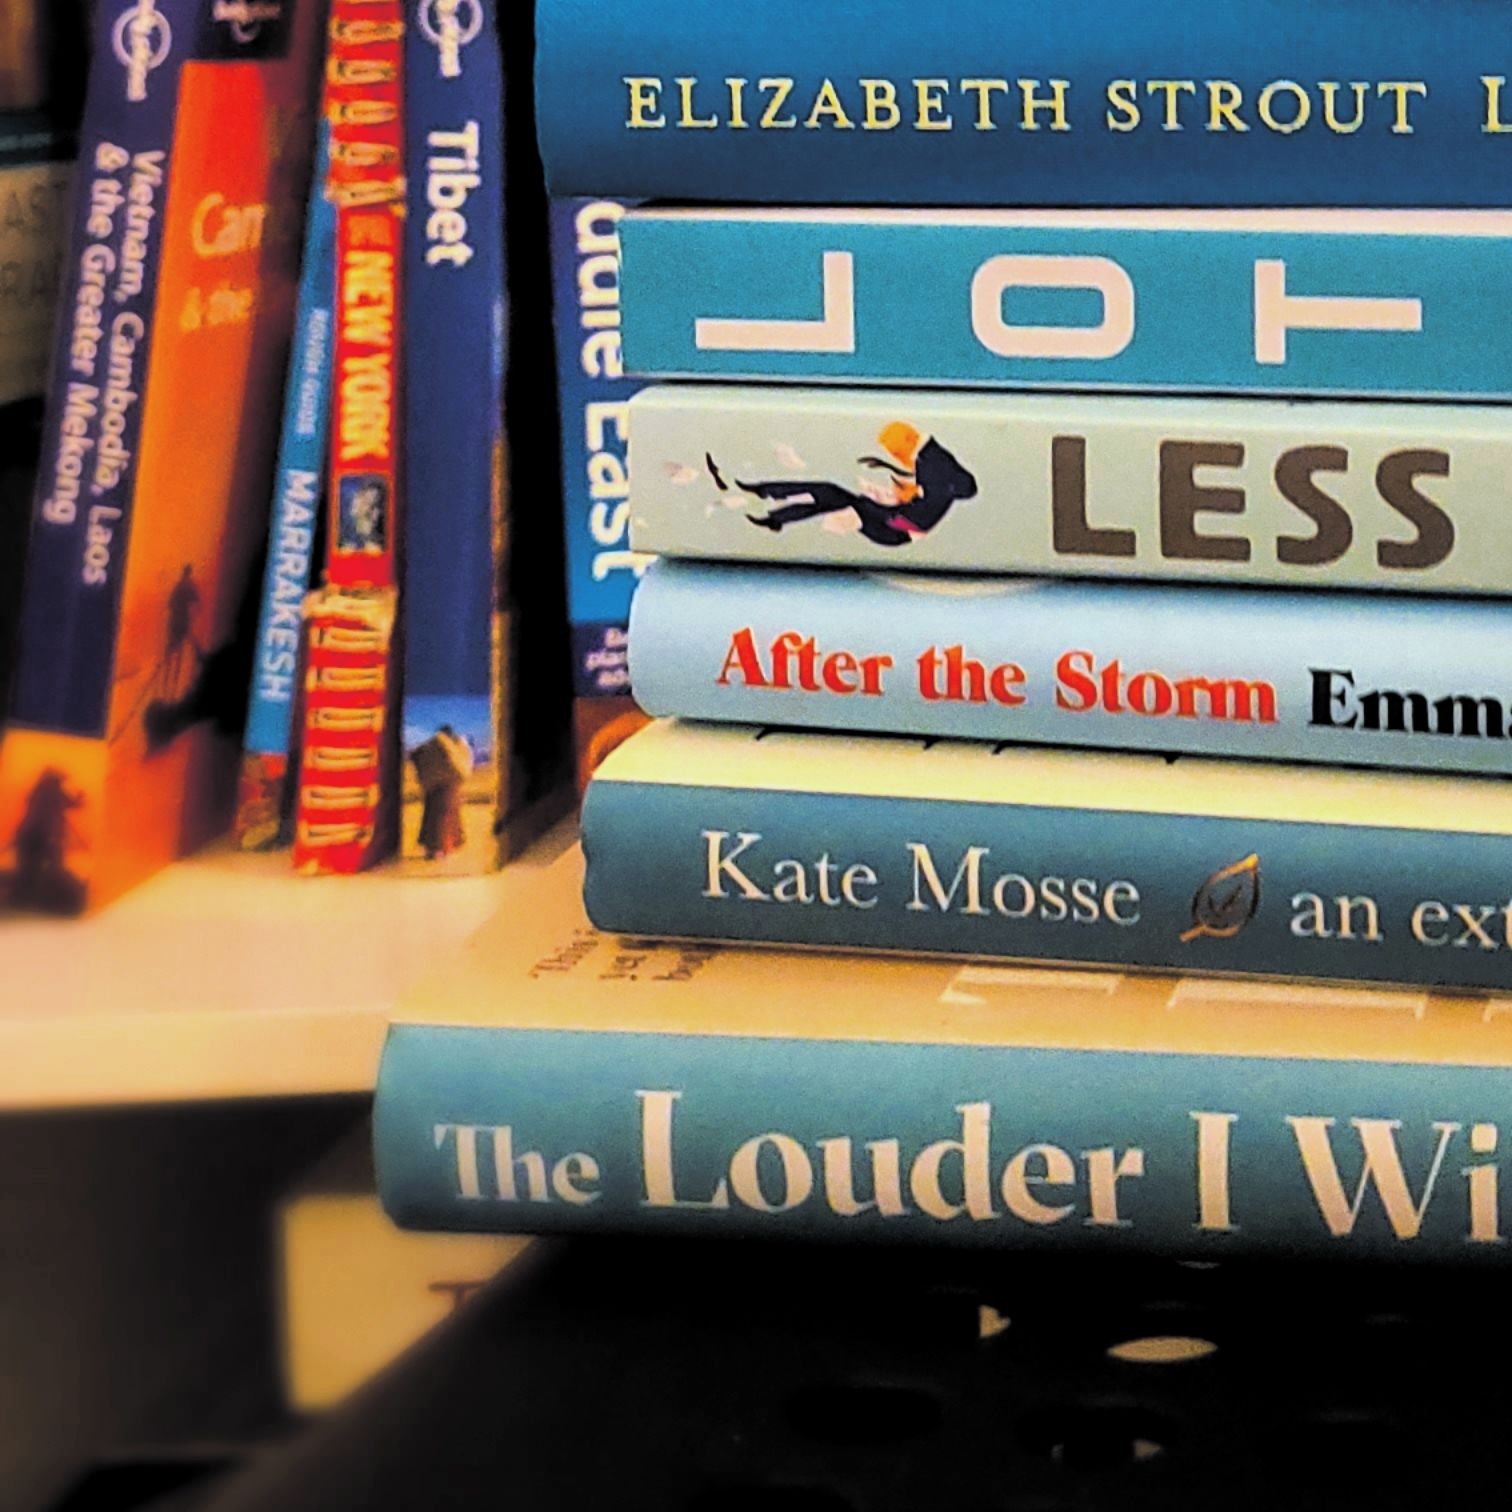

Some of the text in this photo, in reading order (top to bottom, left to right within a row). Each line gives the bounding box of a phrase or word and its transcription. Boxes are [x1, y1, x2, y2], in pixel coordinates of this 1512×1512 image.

[623, 76, 1072, 132] ELIZABETH
[1105, 77, 1427, 134] STROUT
[117, 149, 166, 305] Vietnam,
[426, 120, 482, 267] Tibet
[43, 141, 131, 526] & the Greater Mekong
[340, 249, 394, 463] NEW YORK
[695, 250, 1422, 365] LOT
[90, 310, 145, 496] Cambodia,
[82, 506, 122, 586] Laos
[1051, 435, 1455, 571] LESS
[259, 468, 319, 703] MARRAKESH
[716, 627, 893, 697] After
[916, 644, 1027, 706] the
[1055, 649, 1280, 724] Storm
[700, 829, 879, 910] Kate
[907, 841, 1142, 926] Mosse
[1288, 891, 1384, 943] an
[433, 1123, 600, 1206] The
[635, 1088, 1145, 1229] Louder
[1189, 1109, 1241, 1232] I
